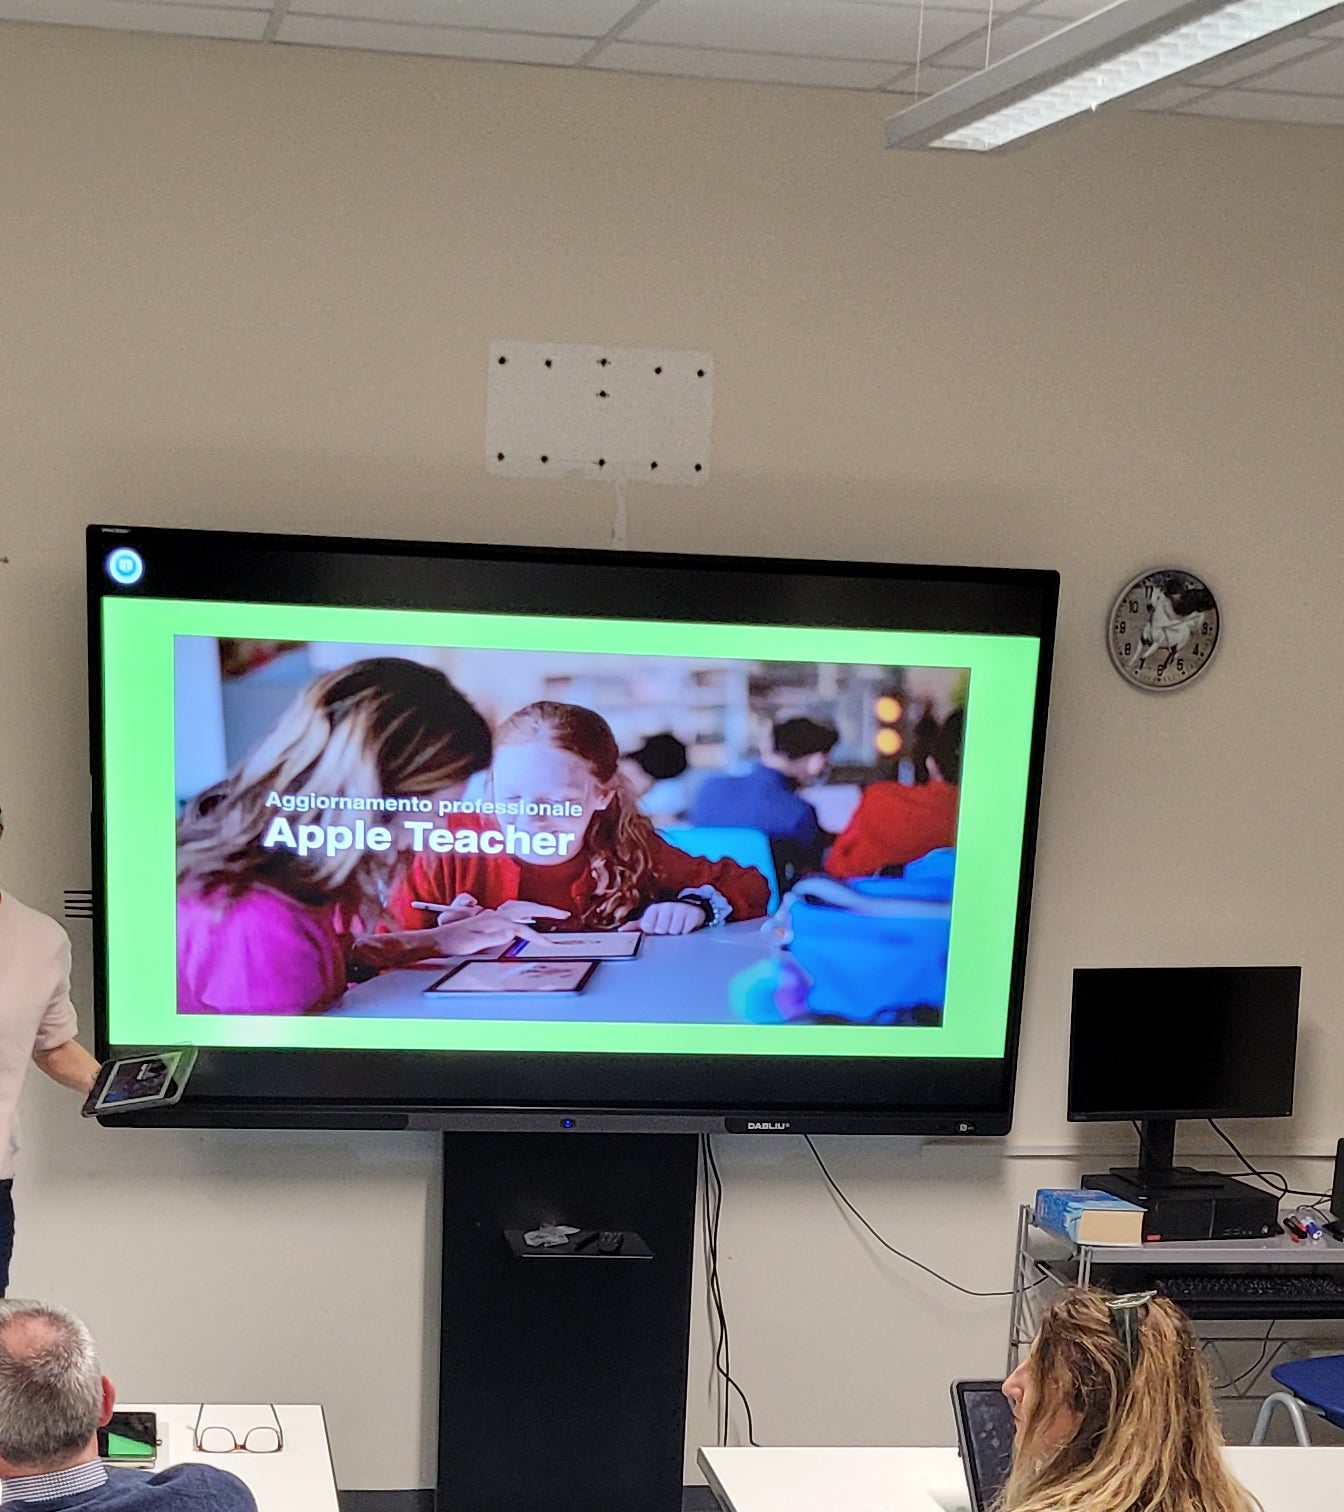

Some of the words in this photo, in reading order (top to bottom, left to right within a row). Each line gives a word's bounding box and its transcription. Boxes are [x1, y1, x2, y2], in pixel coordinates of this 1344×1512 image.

[1129, 600, 1139, 613] 10
[1119, 621, 1126, 633] 9
[1201, 622, 1208, 635] 3
[1124, 643, 1131, 655] 8
[1192, 643, 1199, 655] 4
[1139, 658, 1146, 671] 7
[1157, 664, 1164, 677] 6
[1177, 659, 1184, 671] 5
[265, 791, 433, 815] Aggiornamento
[439, 798, 584, 817] professionale
[263, 817, 392, 857] Apple
[403, 820, 576, 857] Teacher
